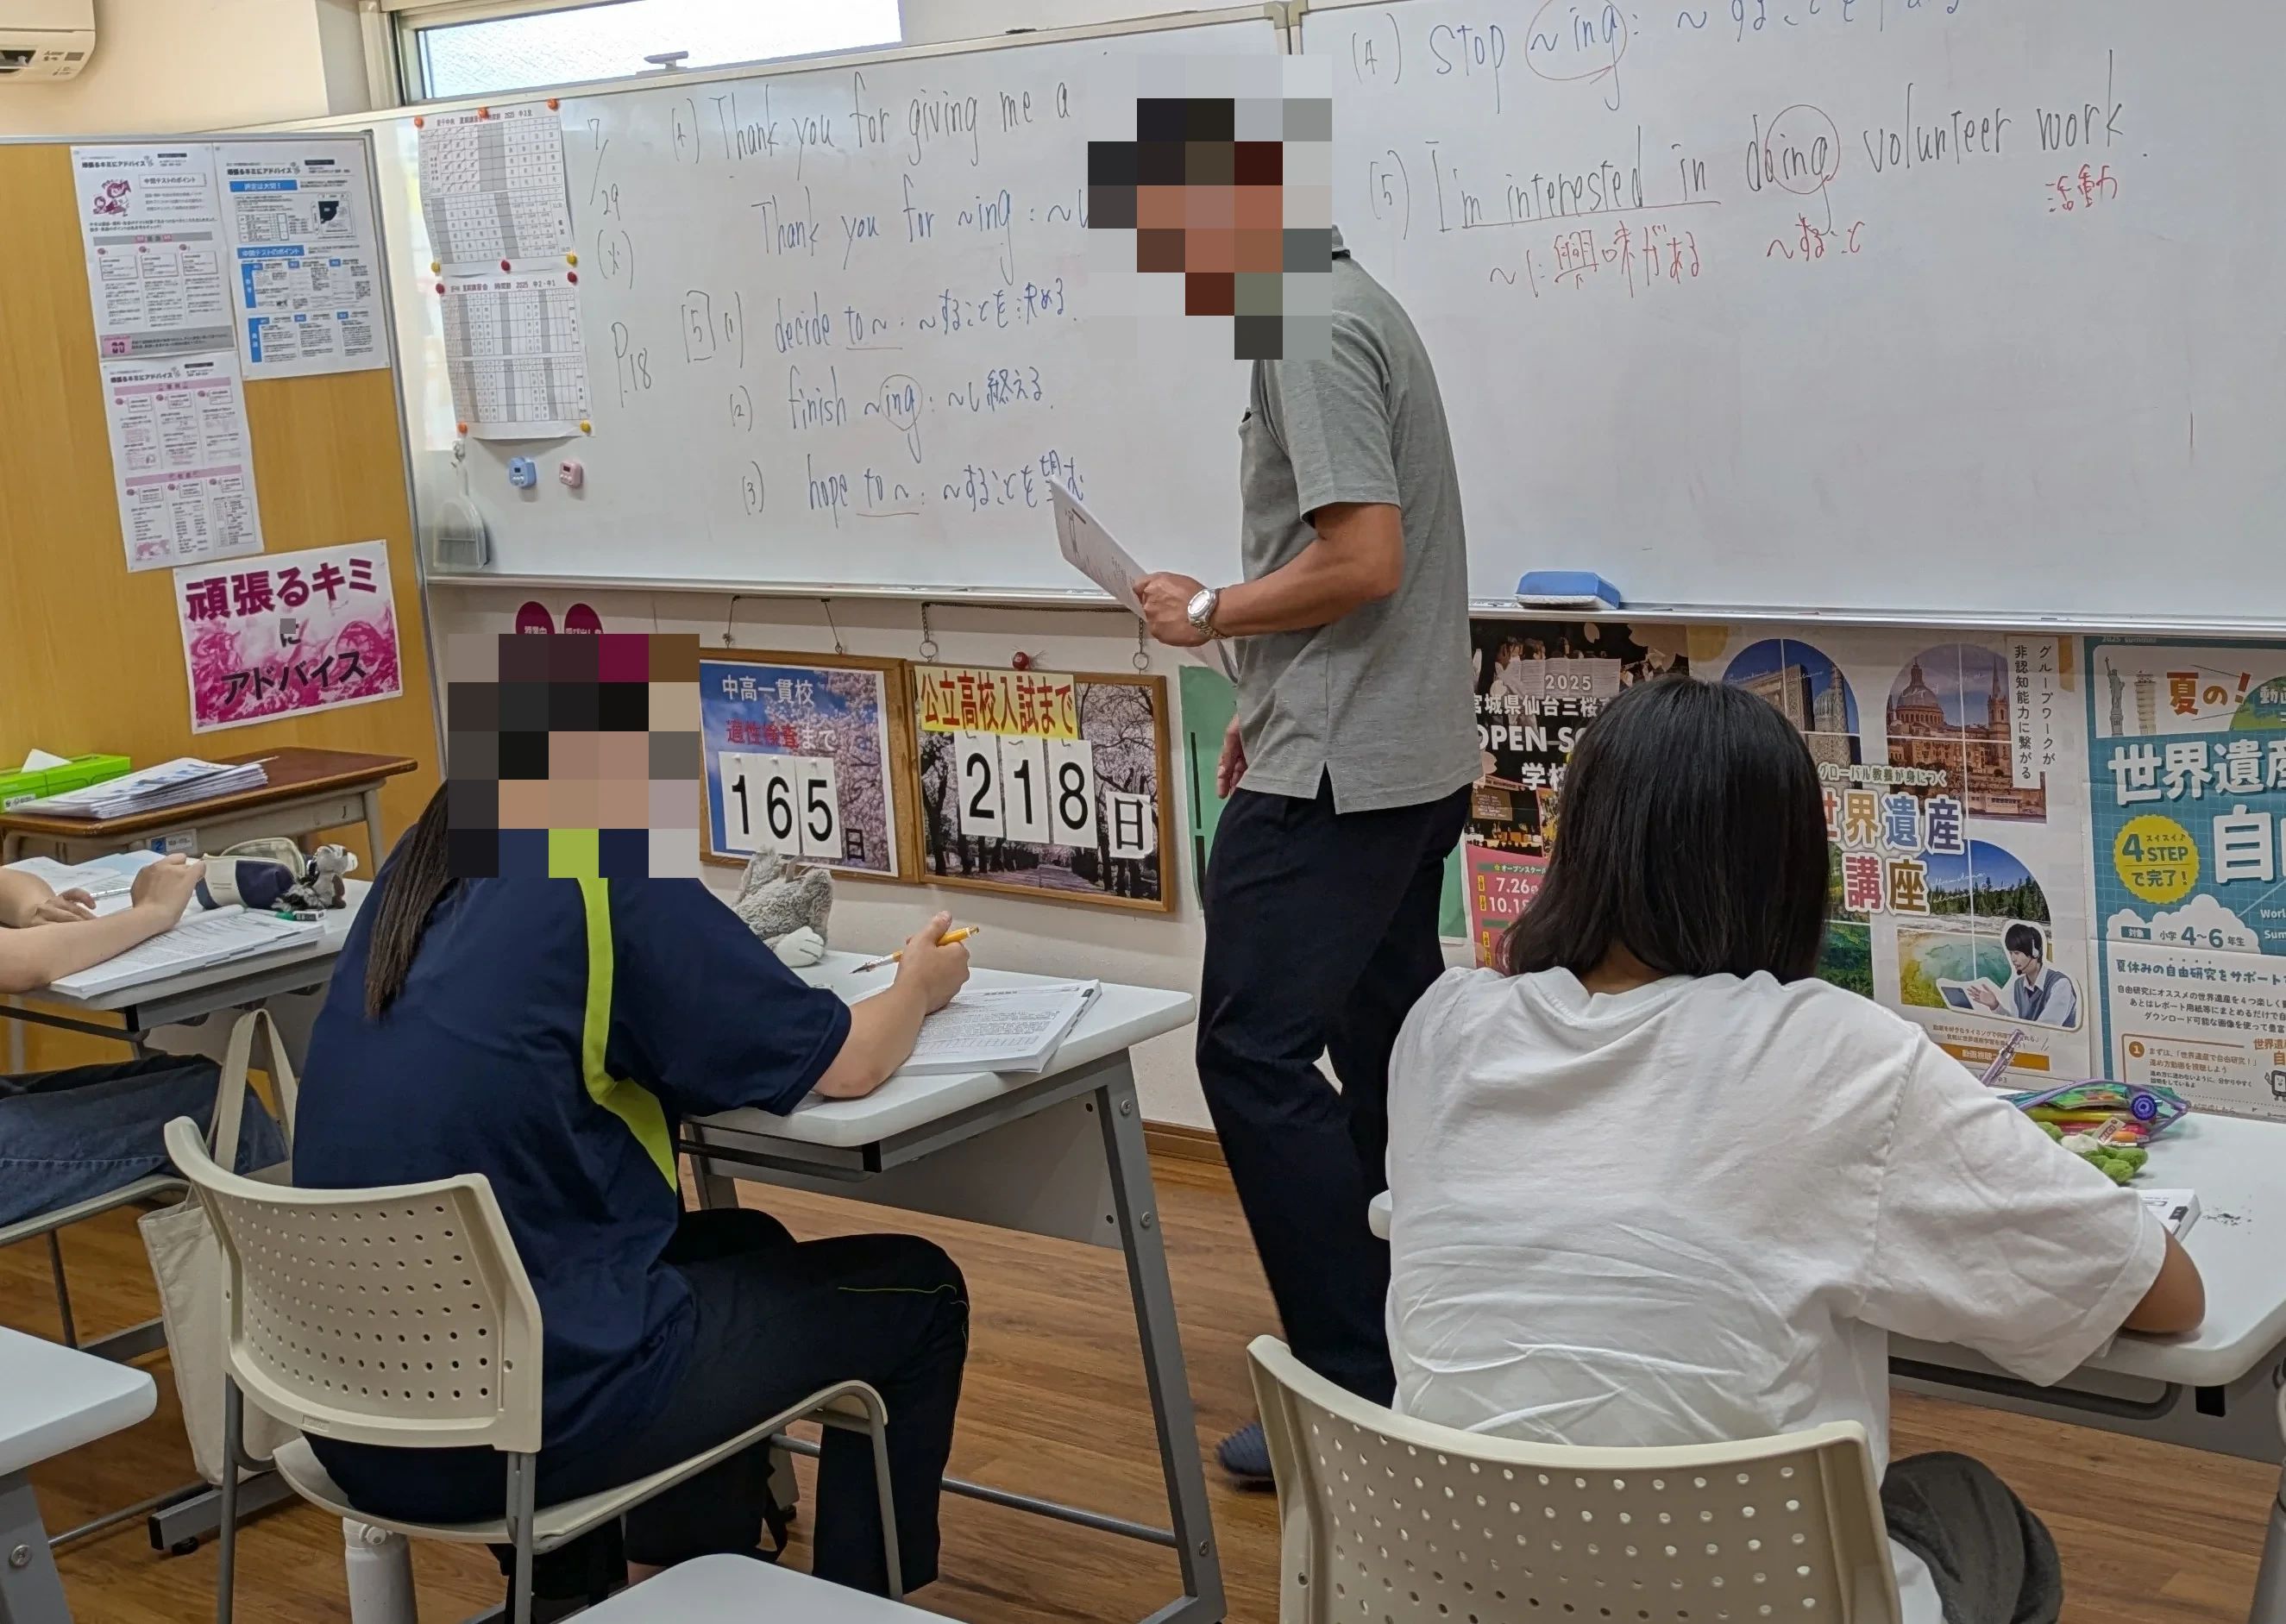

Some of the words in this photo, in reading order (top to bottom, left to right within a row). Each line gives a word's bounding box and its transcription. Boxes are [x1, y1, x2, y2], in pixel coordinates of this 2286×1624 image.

[708, 84, 781, 161] Thank
[791, 113, 837, 180] you
[850, 72, 892, 148] for
[908, 89, 980, 166] giving
[1000, 89, 1036, 129] me
[1057, 82, 1072, 121] a
[1505, 124, 1644, 226] interested
[1670, 143, 1707, 201] in
[1746, 114, 1832, 236] doing
[1862, 83, 2013, 174] volunteer
[2044, 163, 2119, 213] 活動
[750, 186, 820, 256] Thank
[841, 213, 880, 270] you
[902, 173, 937, 244] for
[775, 291, 832, 353] decide
[730, 385, 754, 432] (2)
[789, 365, 848, 429] finish
[742, 460, 764, 517] (3)
[806, 453, 848, 529] hope
[185, 557, 378, 622] 頑張るキミ
[221, 650, 367, 705] アドバイス
[721, 674, 815, 708] 中高一貫校
[920, 669, 1074, 735] 公立高校入試まで
[1543, 674, 1592, 692] 2025
[2038, 645, 2056, 766] グループワークが
[2013, 644, 2032, 780] 非認知能力に繋がる
[965, 752, 1090, 831] 218
[1114, 796, 1145, 851] 日
[1818, 762, 1948, 788] グローバル教養が身につく
[731, 774, 834, 843] 165
[845, 827, 866, 862] 日
[2121, 833, 2145, 862] 4
[2146, 846, 2189, 862] STEP
[1496, 877, 1530, 894] 7.26
[1843, 854, 1929, 914] 講座
[2131, 868, 2189, 887] で完了!
[2116, 957, 2286, 986] 夏休みの自由研究をサポート
